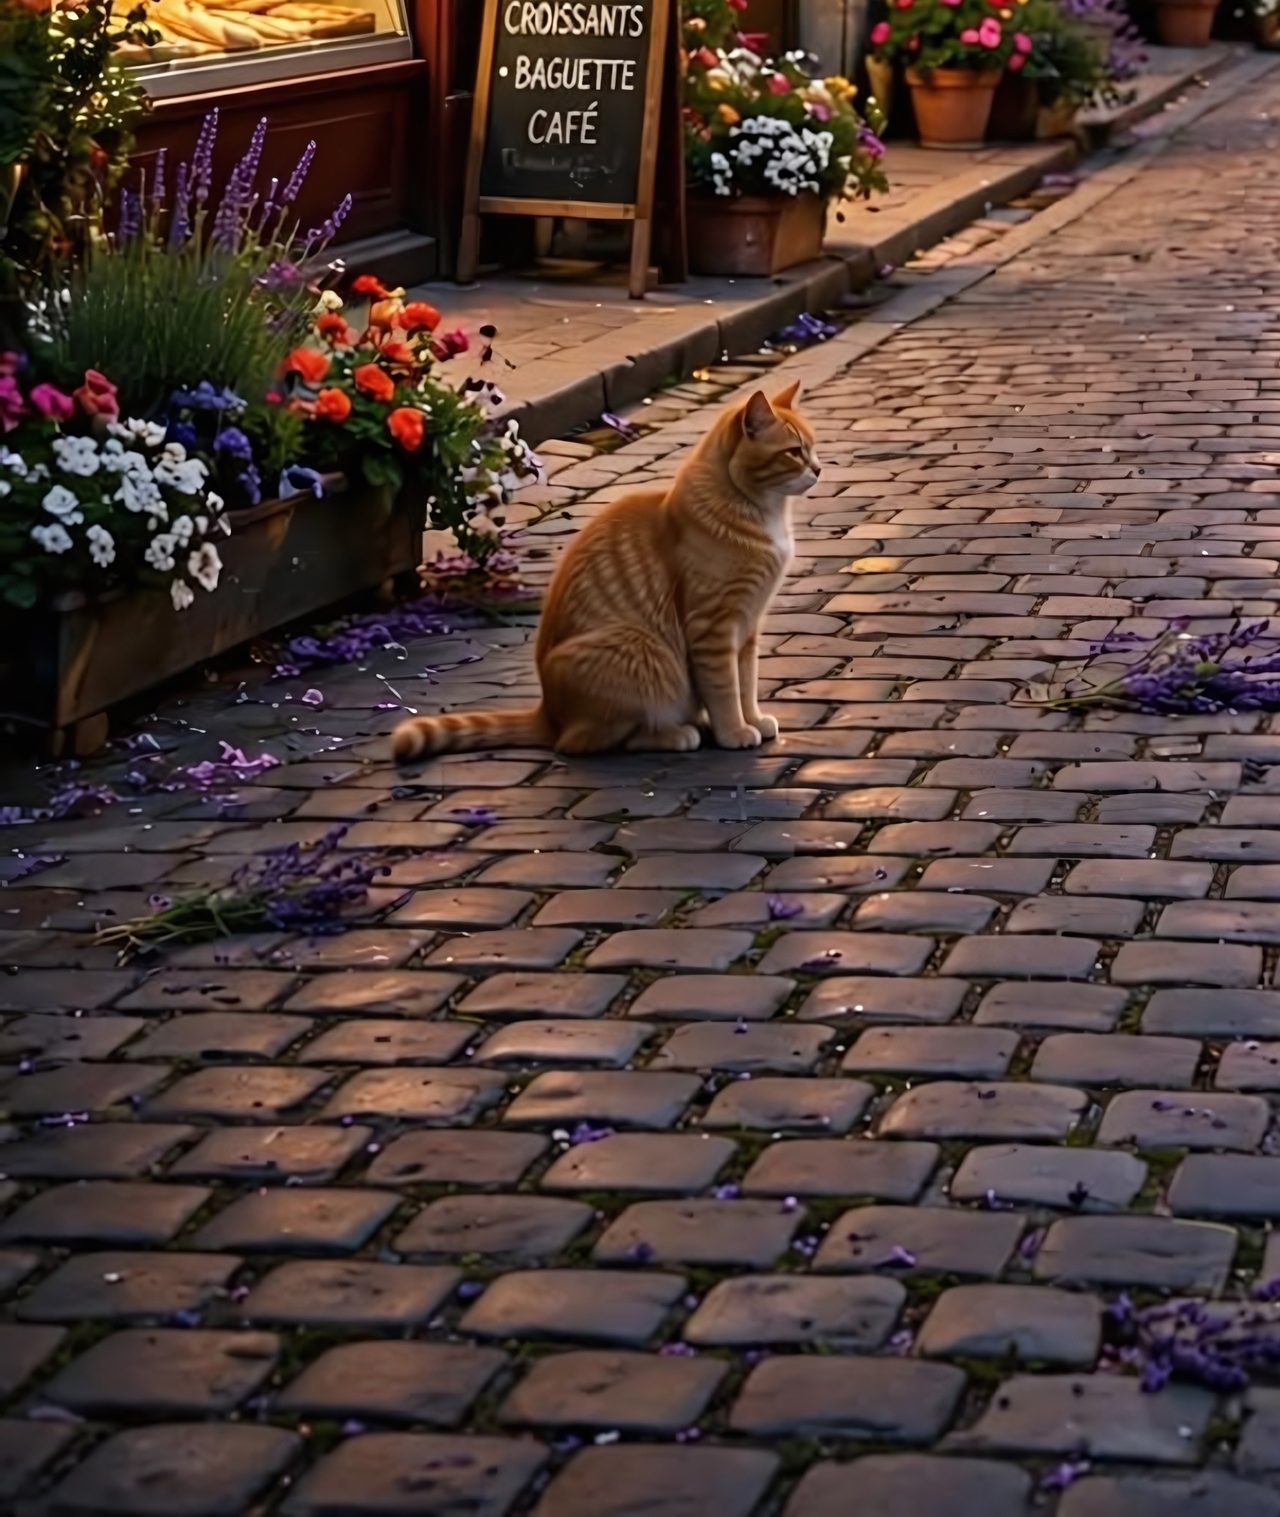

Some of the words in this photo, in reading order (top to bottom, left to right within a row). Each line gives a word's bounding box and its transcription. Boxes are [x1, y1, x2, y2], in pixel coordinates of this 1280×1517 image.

[504, 0, 644, 38] CROISSANTS
[515, 55, 637, 91] BAGUETTE
[528, 101, 599, 145] CAFÉ
